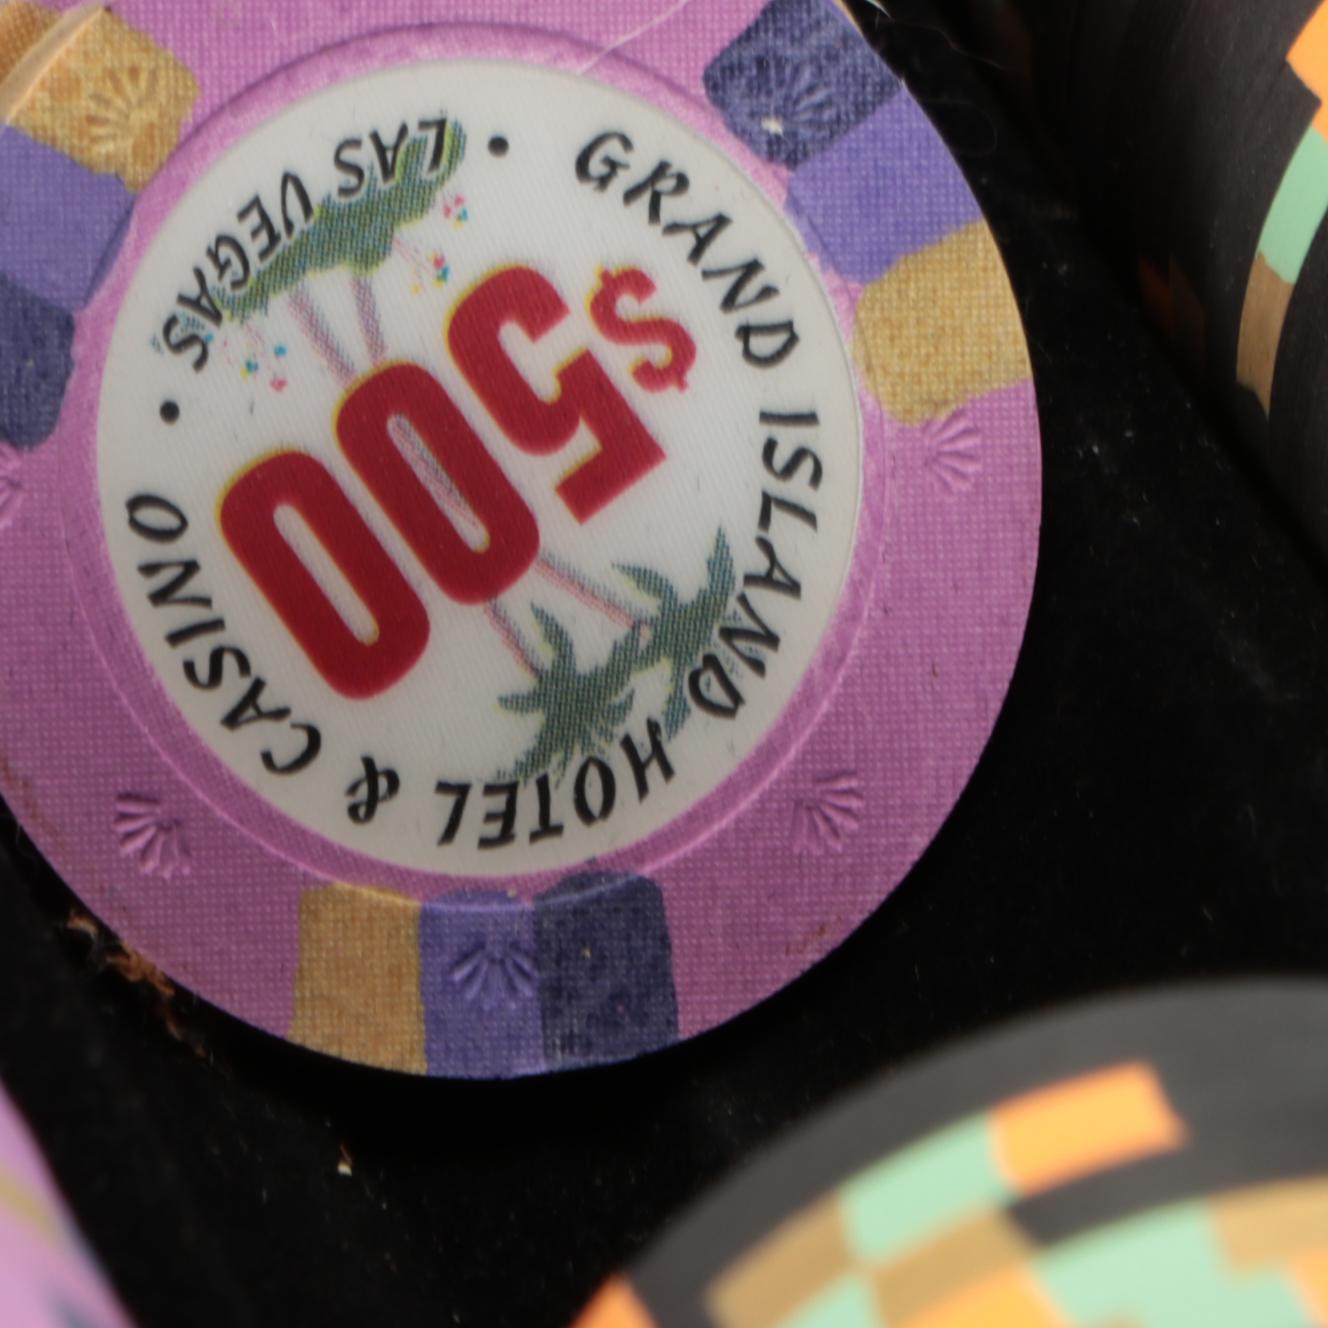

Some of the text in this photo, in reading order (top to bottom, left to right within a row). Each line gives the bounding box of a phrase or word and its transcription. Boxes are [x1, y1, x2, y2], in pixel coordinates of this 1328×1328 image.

[162, 118, 449, 372] LAS VEGAS
[126, 131, 823, 850] GRAND ISLAND HOTEL & CASINO
[215, 265, 697, 701] $500
